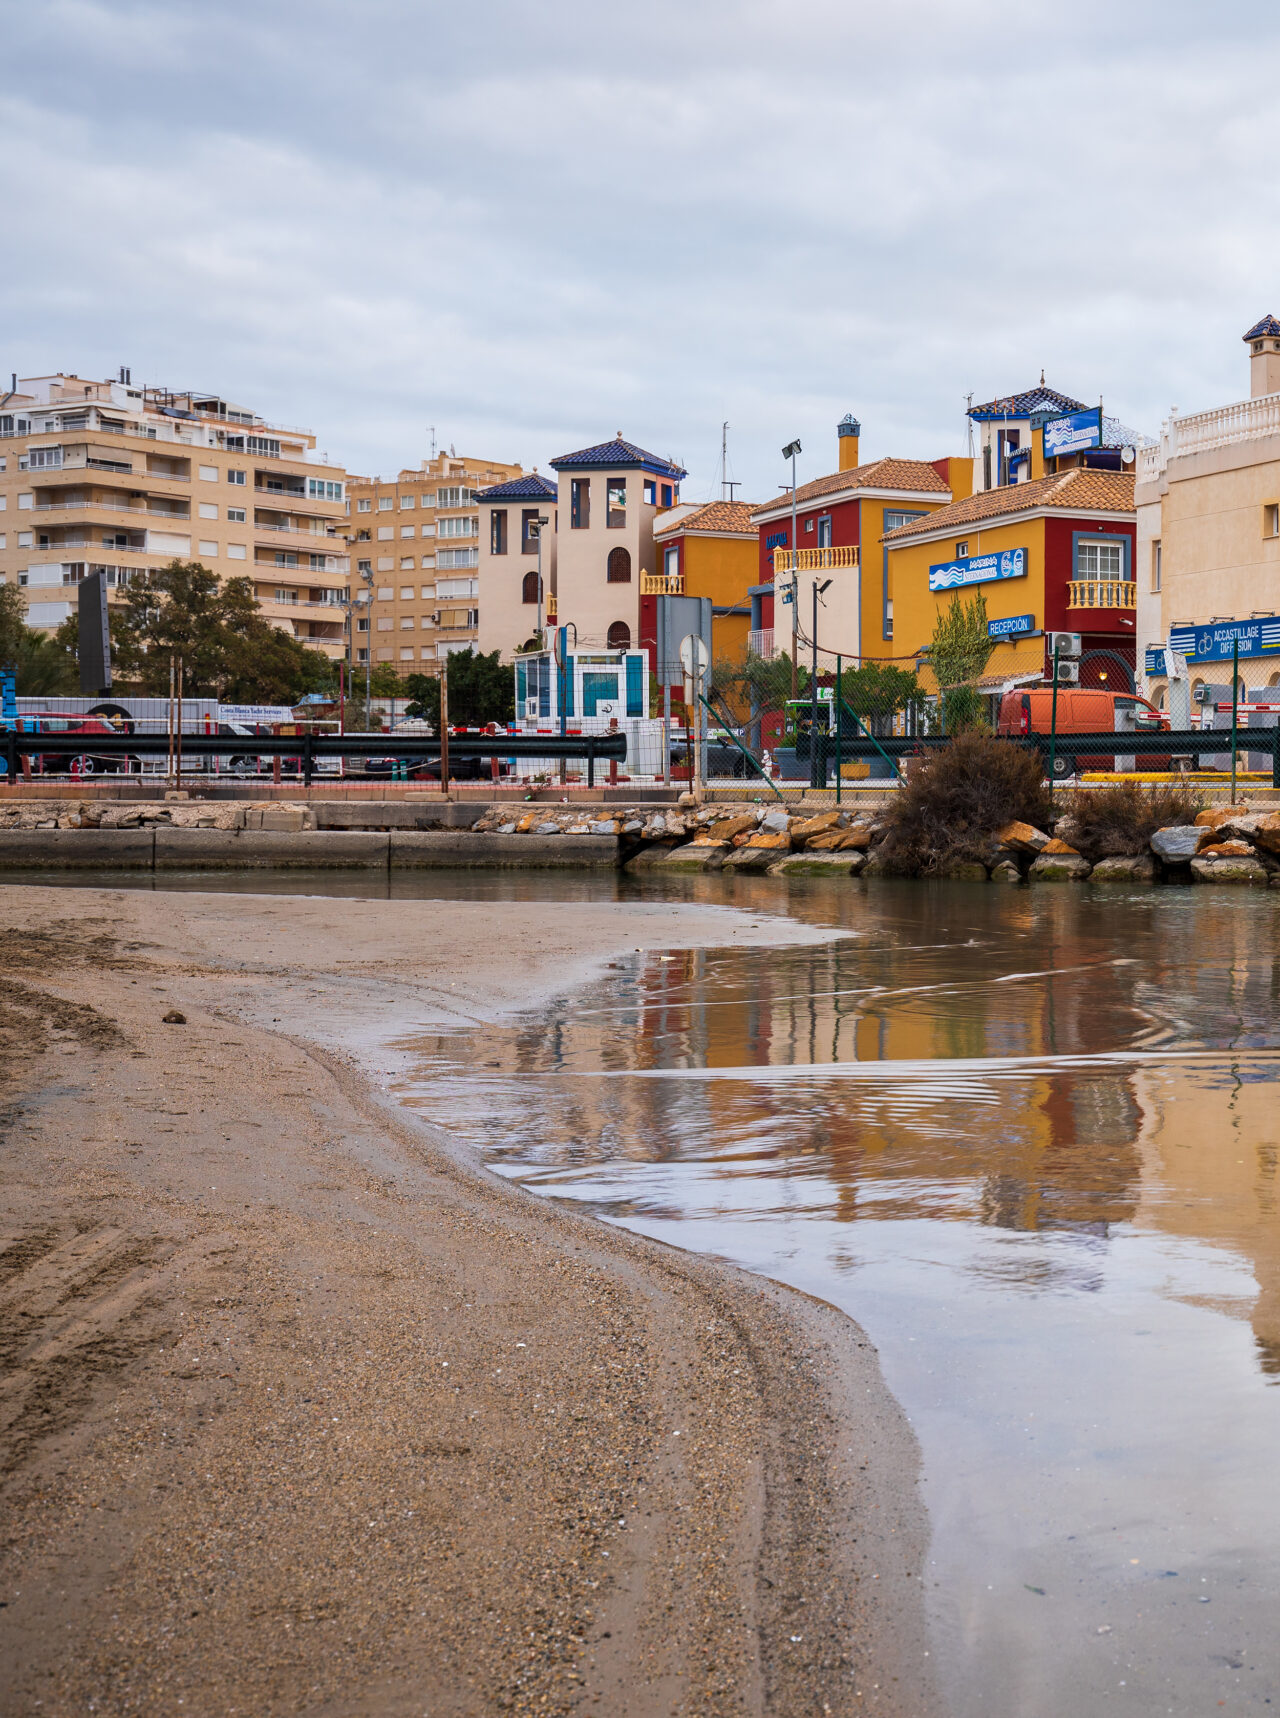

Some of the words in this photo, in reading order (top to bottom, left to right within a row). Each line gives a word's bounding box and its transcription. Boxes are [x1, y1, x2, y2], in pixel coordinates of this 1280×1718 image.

[969, 556, 998, 569] MARINA
[990, 617, 1028, 634] RECEPCIÓN
[1214, 625, 1259, 642] ACCASTILLAGE
[1220, 639, 1253, 654] DIFFSION
